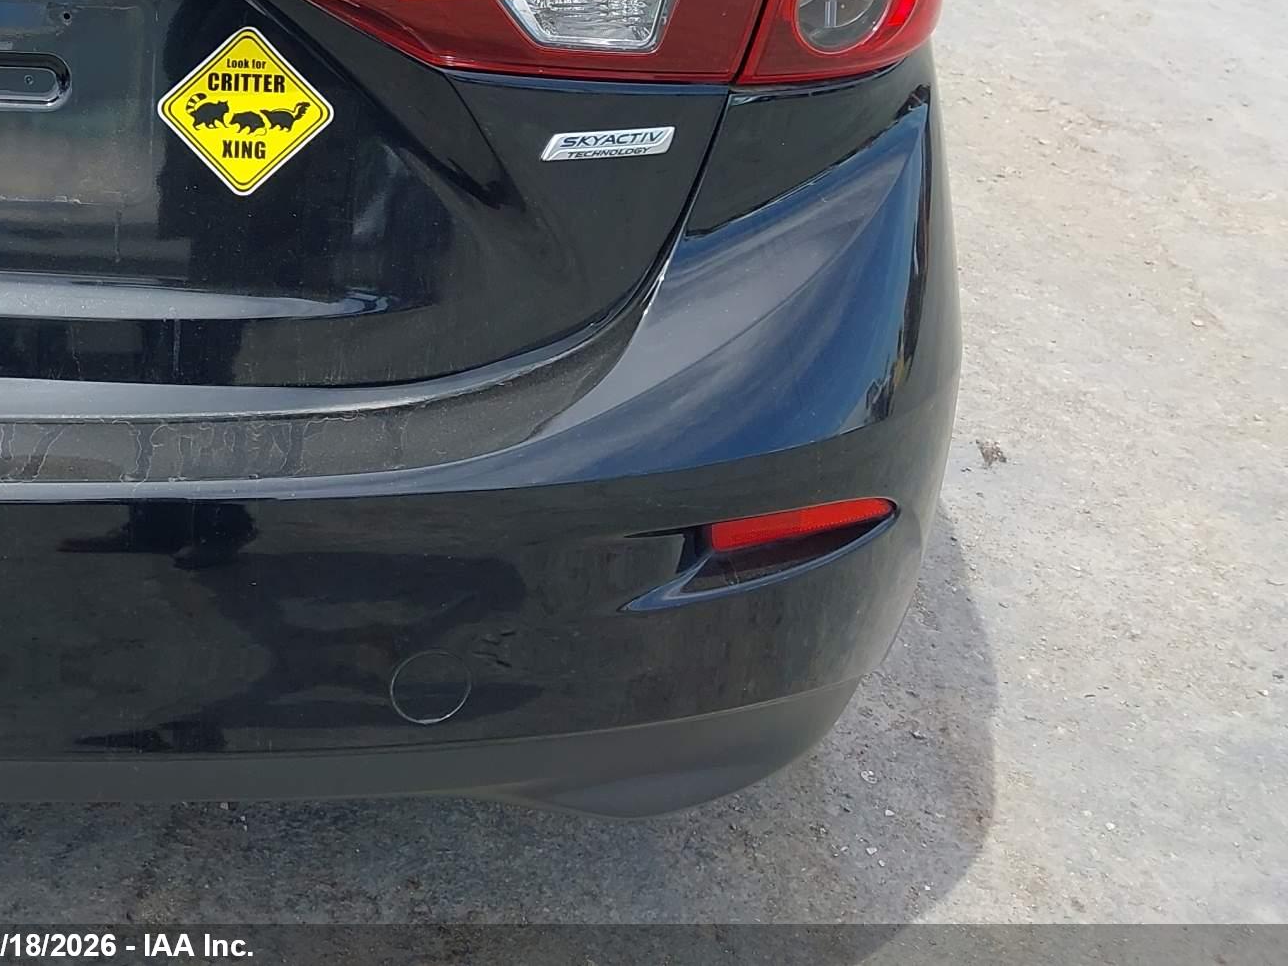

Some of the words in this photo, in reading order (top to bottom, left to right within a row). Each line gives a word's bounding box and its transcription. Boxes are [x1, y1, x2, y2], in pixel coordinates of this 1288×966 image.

[226, 58, 249, 69] Look
[252, 58, 267, 70] for
[207, 72, 286, 94] CRITTER
[560, 131, 664, 148] SKYACTIV
[222, 139, 267, 160] XING
[567, 146, 651, 159] TECHNOLOGY
